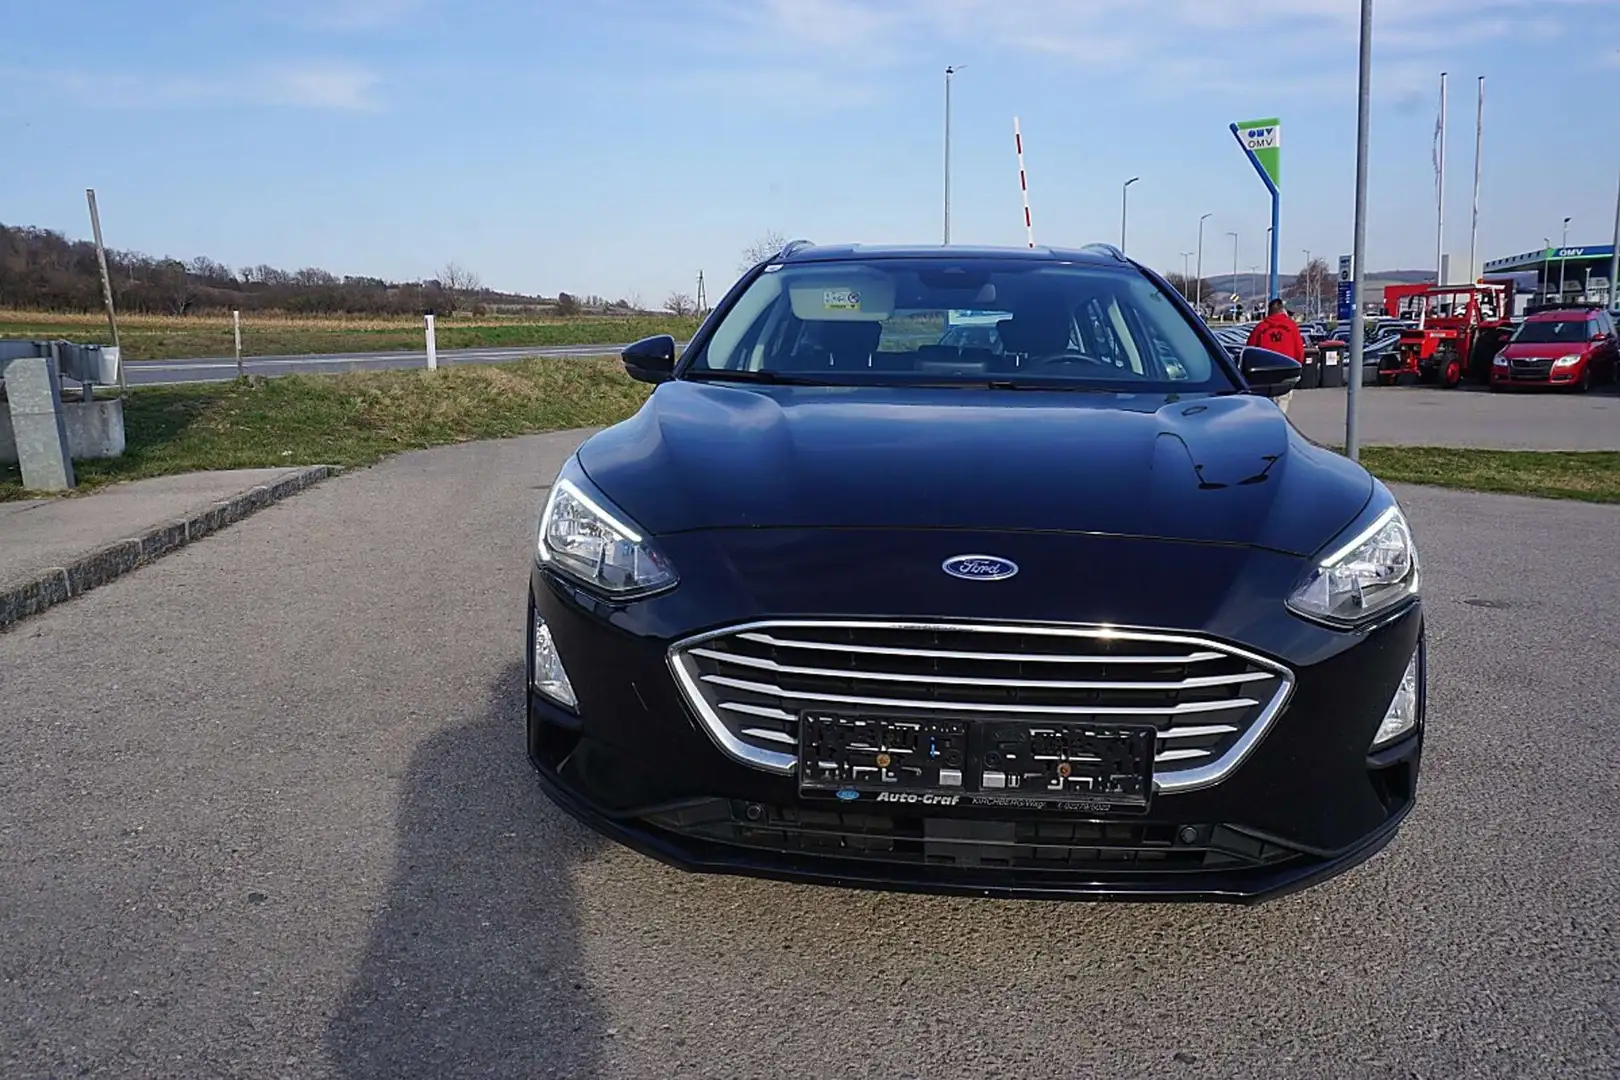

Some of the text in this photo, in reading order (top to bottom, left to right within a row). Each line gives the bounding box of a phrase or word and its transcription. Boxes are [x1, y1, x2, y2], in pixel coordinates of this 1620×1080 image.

[1248, 139, 1273, 149] OMV
[1559, 248, 1584, 257] OMV
[960, 560, 1000, 574] Ford
[877, 792, 959, 806] Auto-Graf
